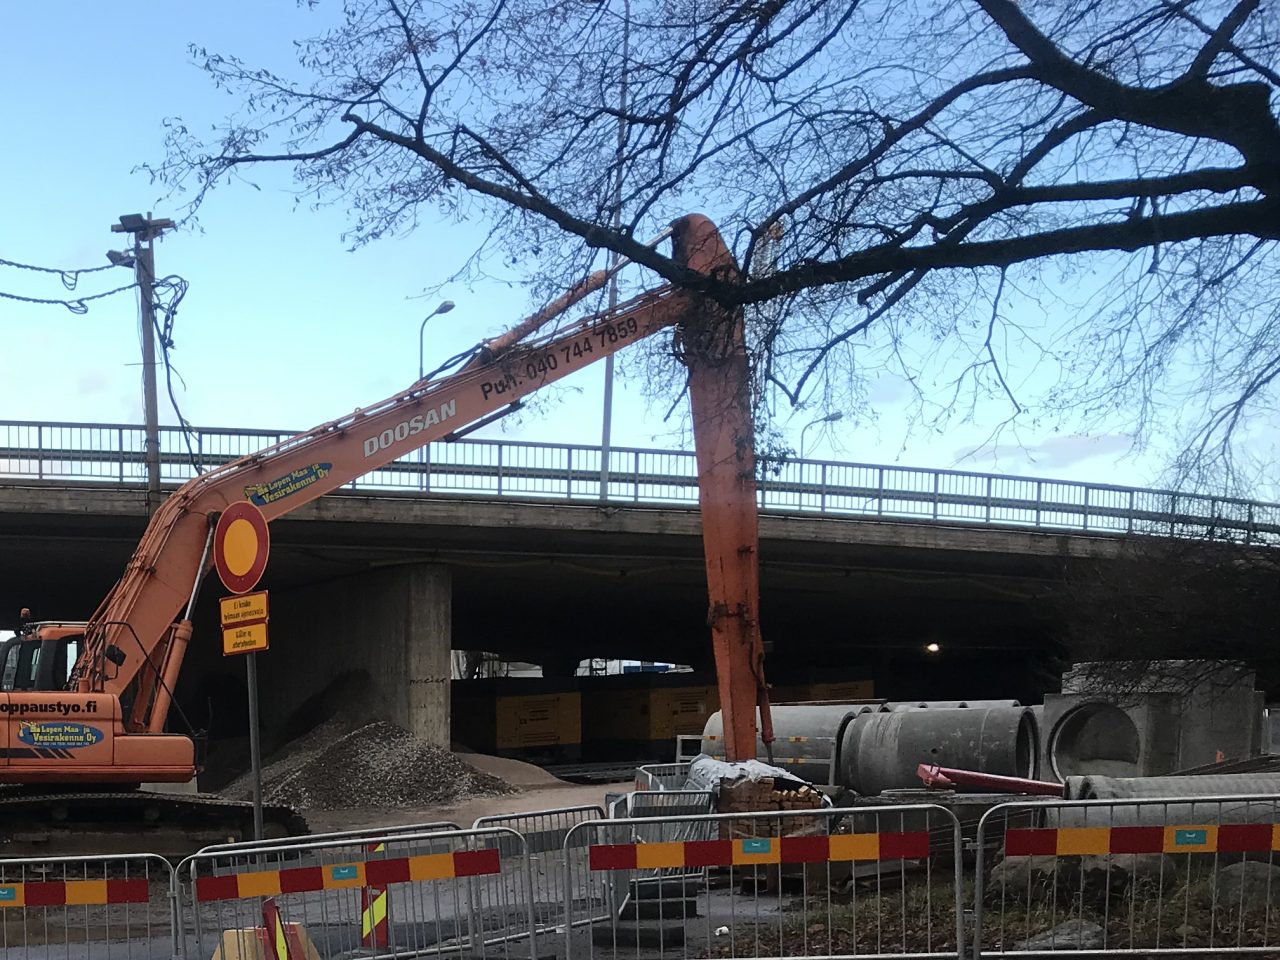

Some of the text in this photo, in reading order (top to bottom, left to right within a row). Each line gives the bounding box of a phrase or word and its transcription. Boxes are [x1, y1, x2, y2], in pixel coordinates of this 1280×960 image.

[525, 353, 559, 380] 040
[561, 336, 593, 364] 744
[597, 317, 639, 348] 7859
[363, 399, 457, 458] DOOSAN
